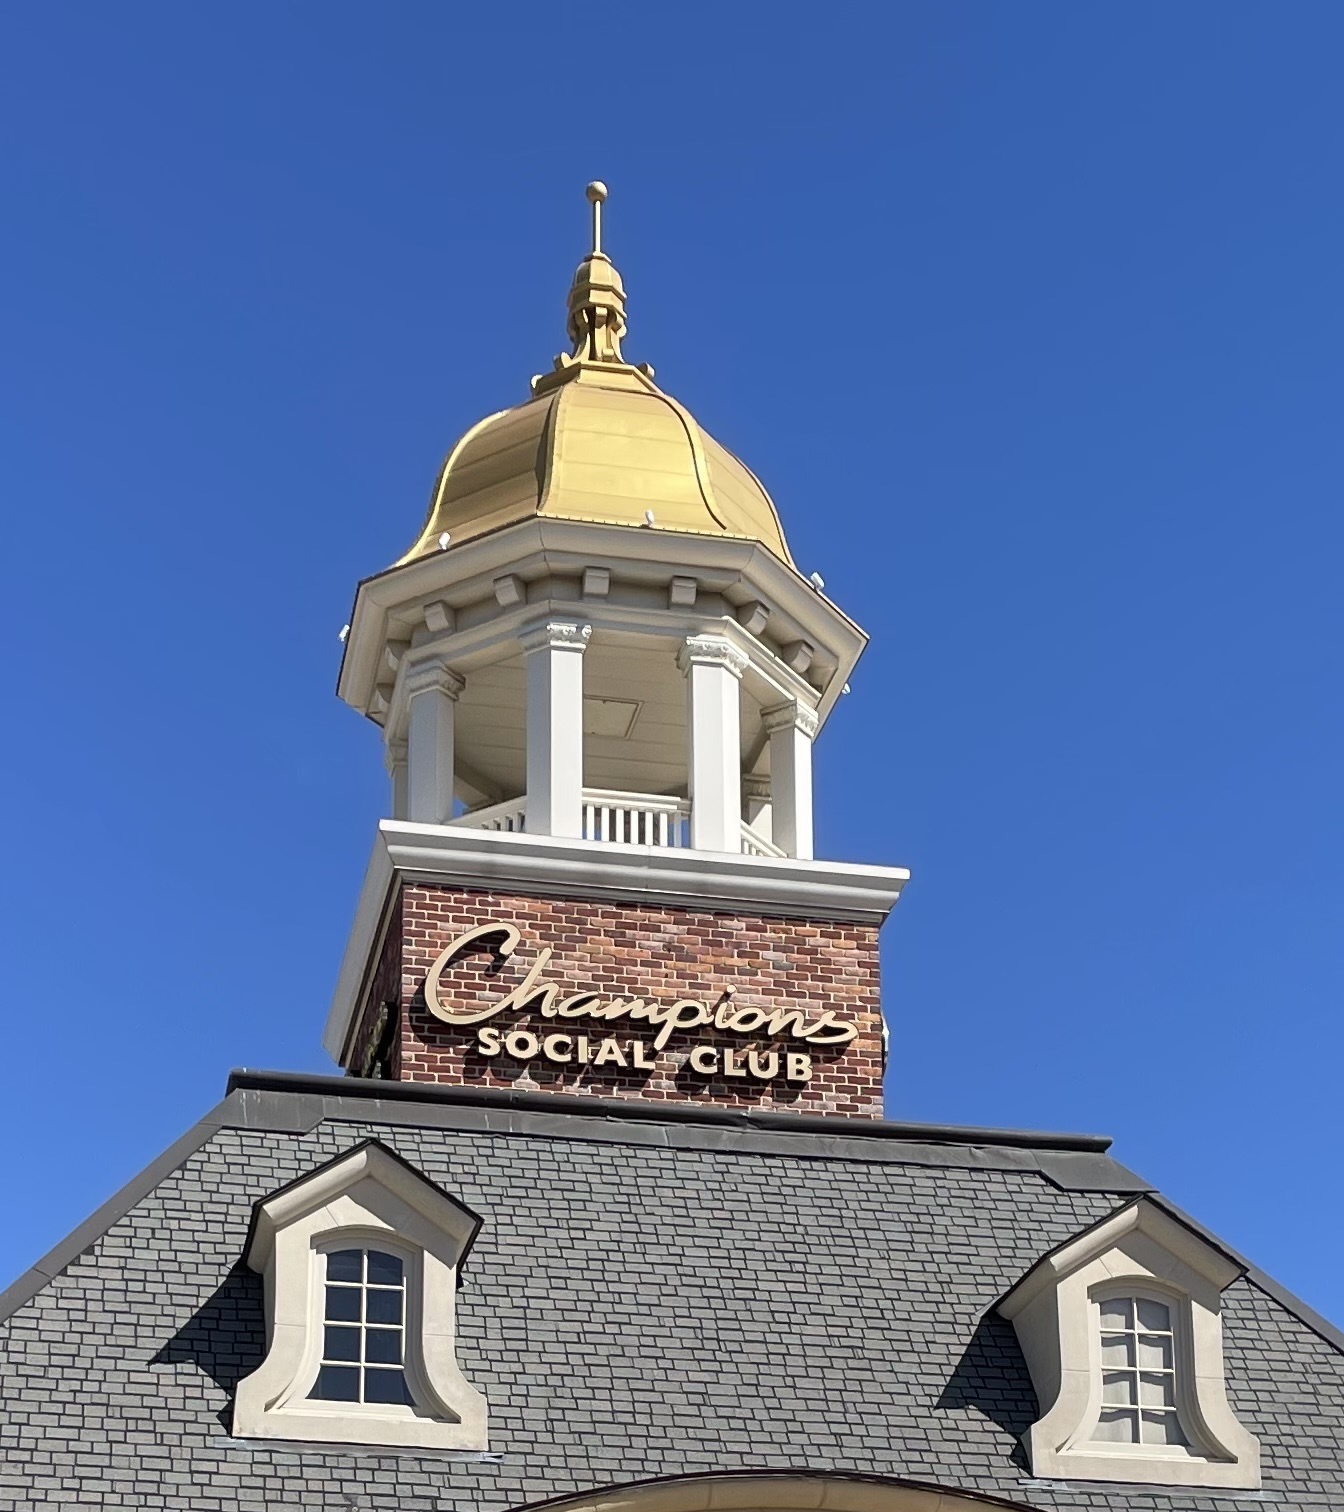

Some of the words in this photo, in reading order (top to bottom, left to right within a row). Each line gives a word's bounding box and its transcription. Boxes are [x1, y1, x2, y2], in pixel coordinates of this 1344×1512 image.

[425, 922, 859, 1050] Champions
[477, 1028, 656, 1069] SOCIAL
[690, 1046, 813, 1081] CLUB
